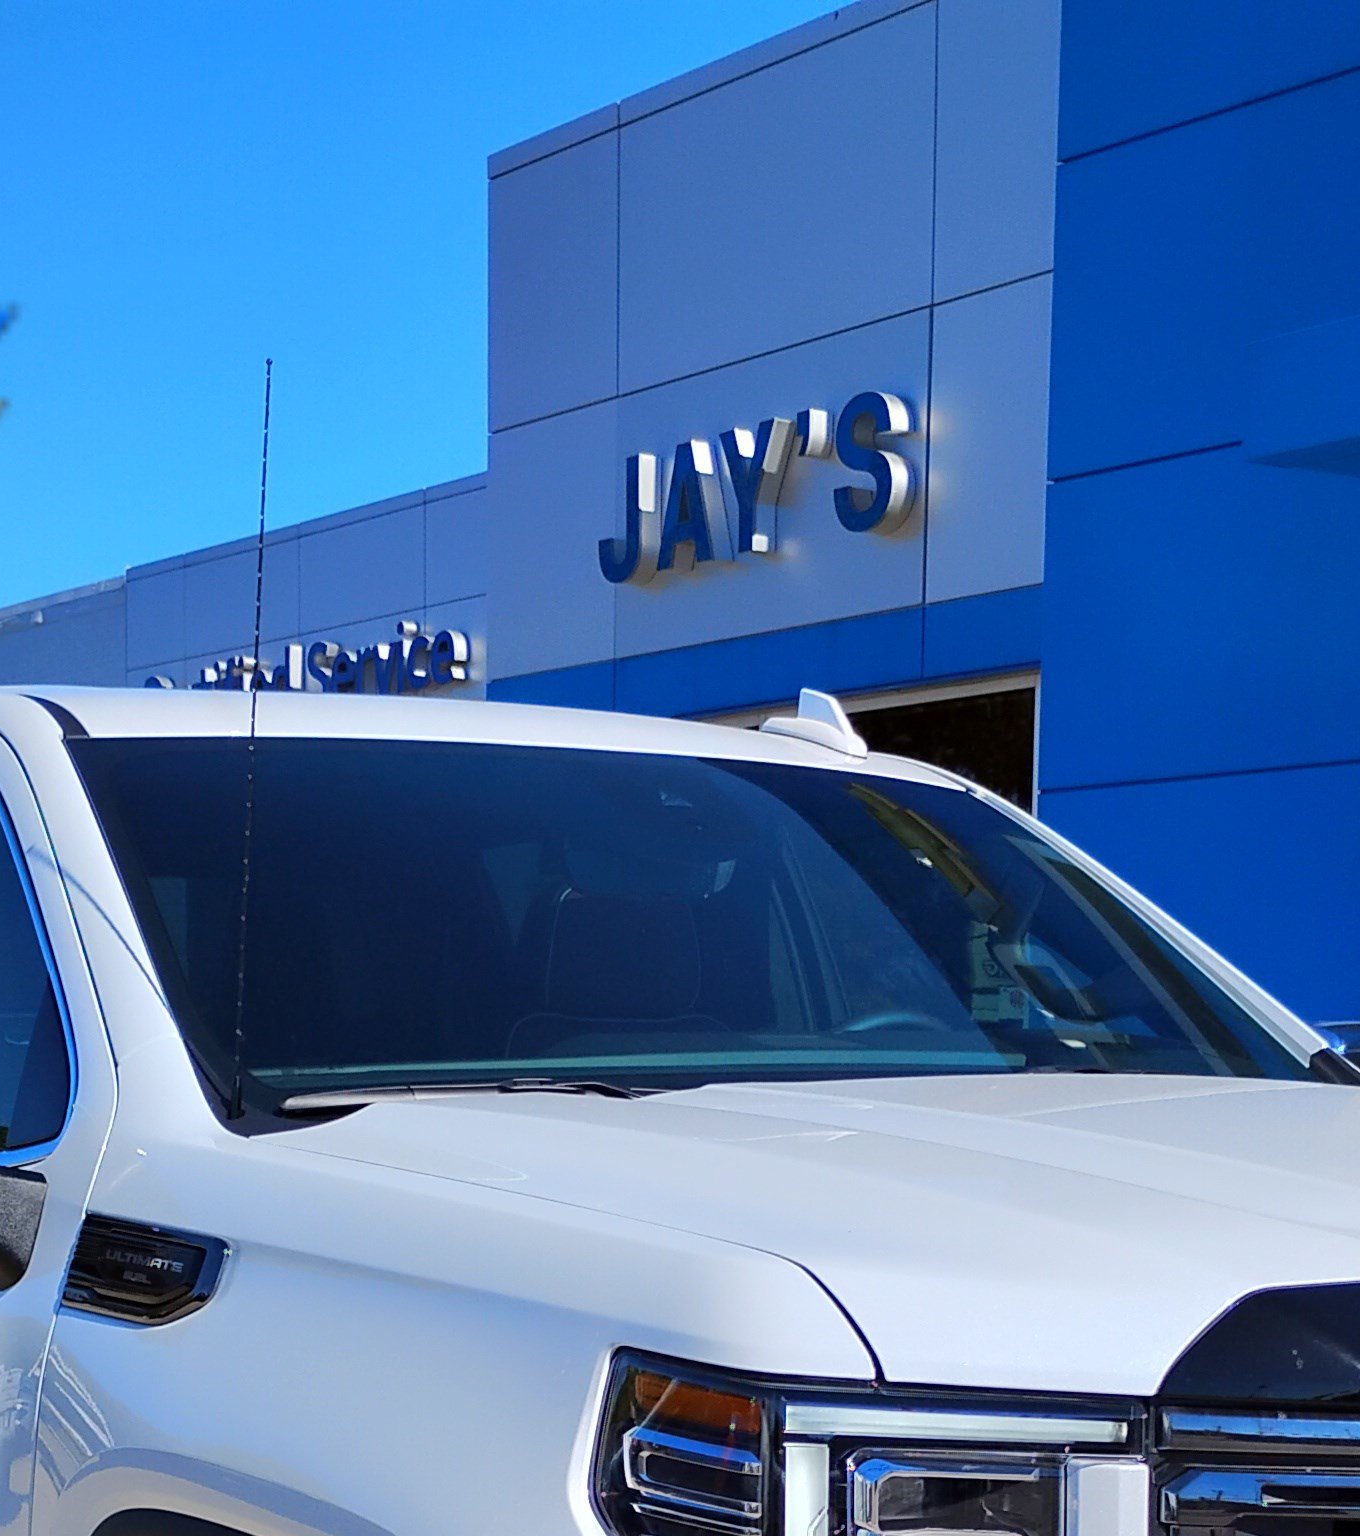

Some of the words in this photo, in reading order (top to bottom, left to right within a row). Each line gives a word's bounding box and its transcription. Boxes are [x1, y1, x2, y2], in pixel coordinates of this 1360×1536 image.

[598, 389, 917, 588] JAY'S
[307, 620, 471, 695] Service
[106, 1249, 184, 1273] ULTIMATE
